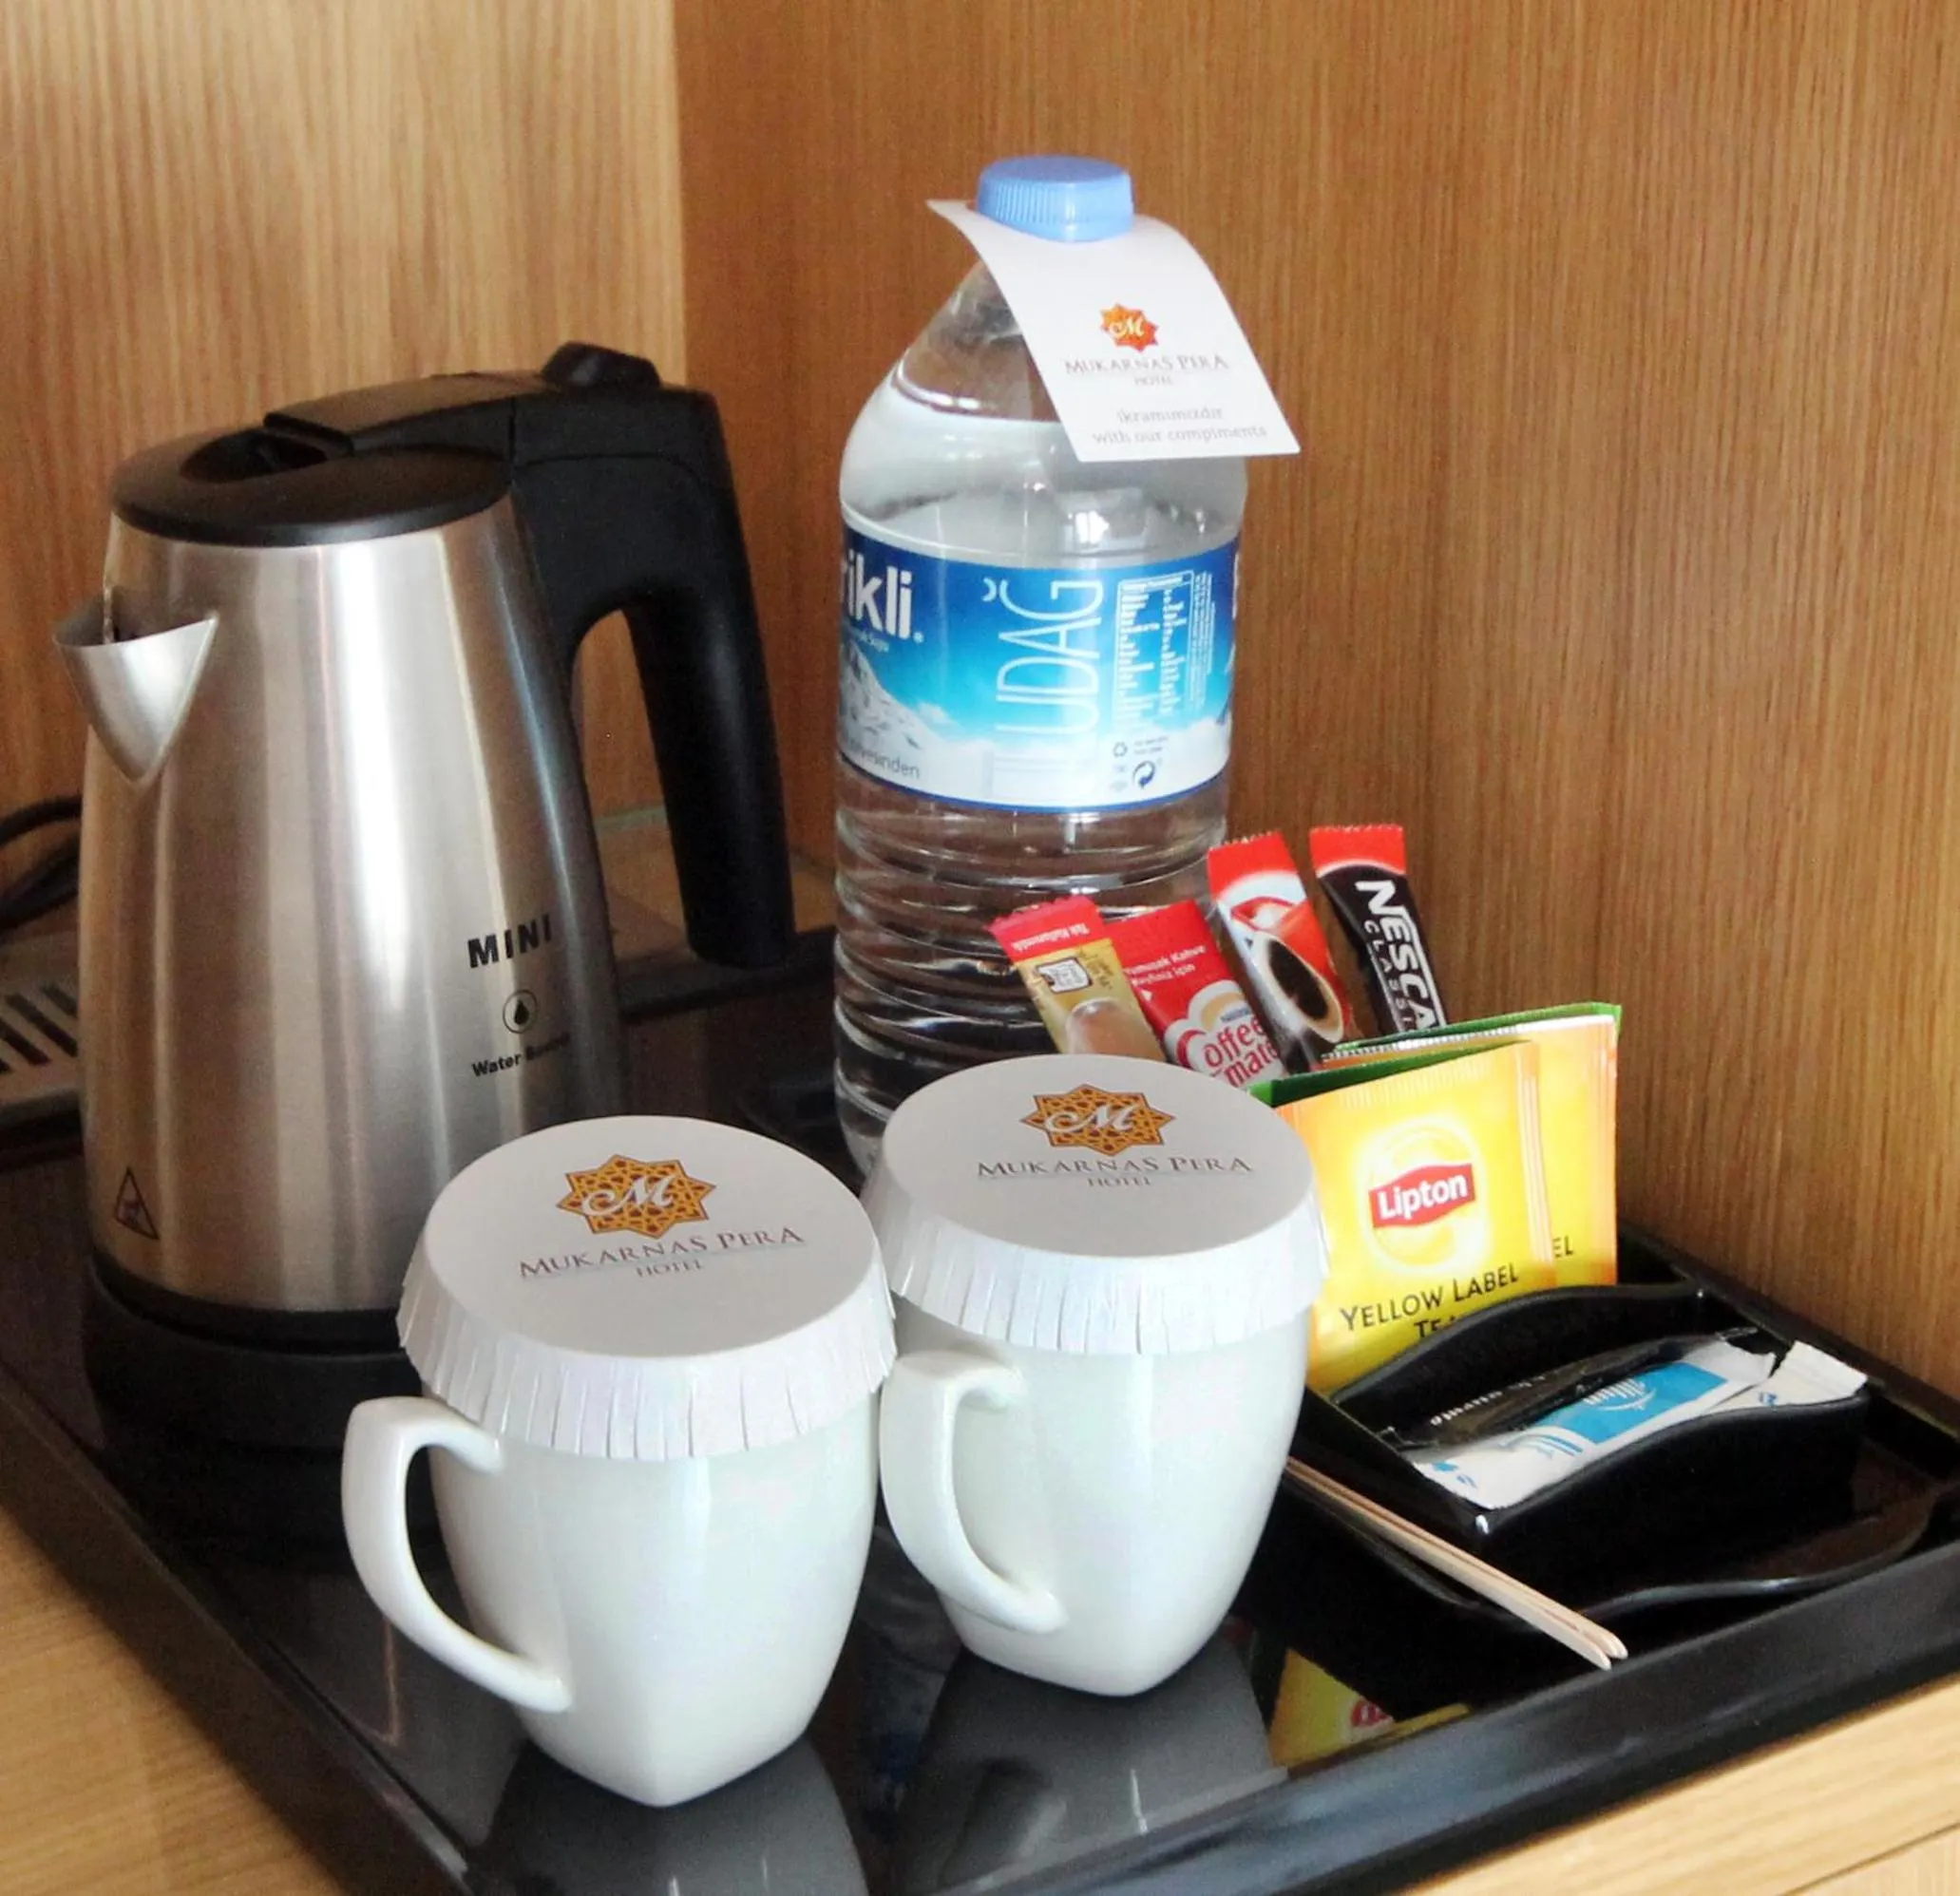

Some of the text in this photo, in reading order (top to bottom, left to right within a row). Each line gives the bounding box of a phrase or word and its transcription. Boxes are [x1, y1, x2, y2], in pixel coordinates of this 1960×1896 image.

[467, 913, 552, 969] MINI
[1362, 919, 1416, 1035] CLASSI
[471, 1053, 522, 1077] Water
[977, 1154, 1253, 1178] MUKARNAS PERA
[1378, 1173, 1468, 1221] Lipton
[519, 1224, 806, 1279] MUKARNAS PERA
[635, 1261, 705, 1279] HOTEL
[1340, 1262, 1519, 1331] YELLOW LABEL
[1414, 1316, 1456, 1337] TE
